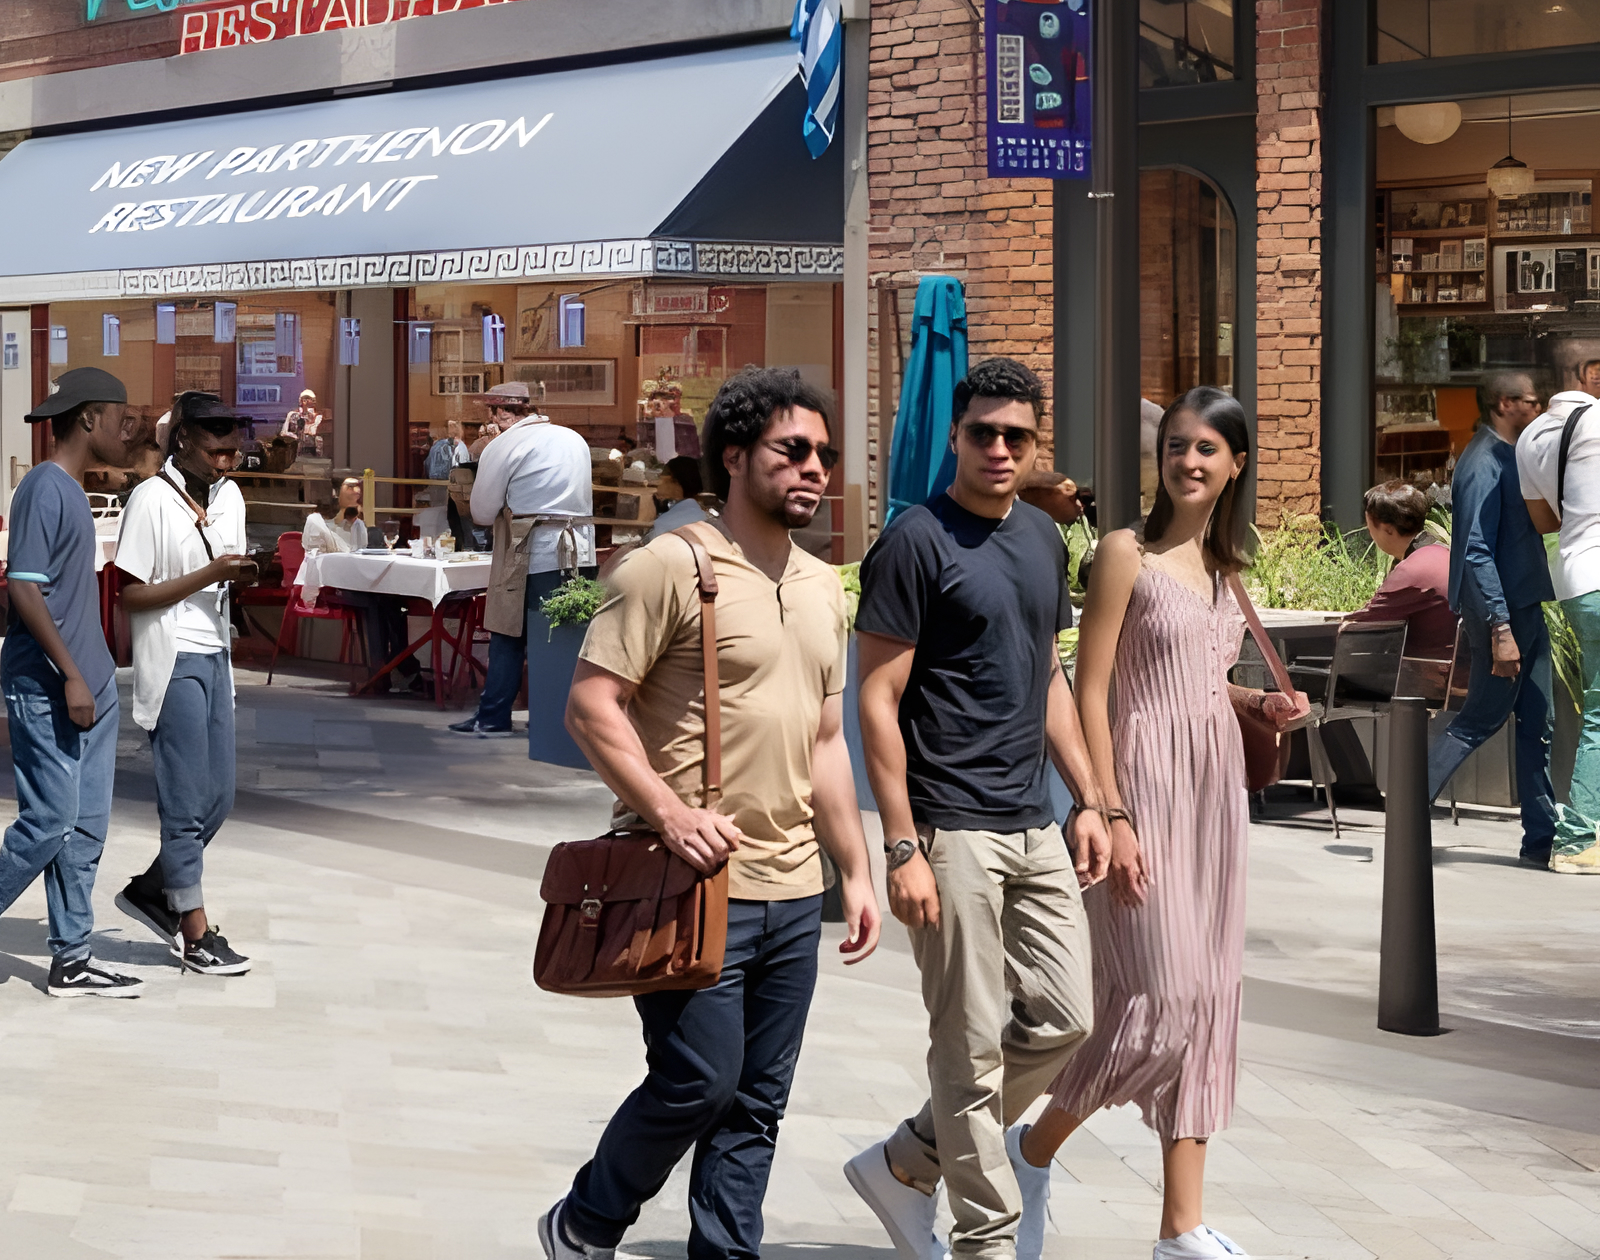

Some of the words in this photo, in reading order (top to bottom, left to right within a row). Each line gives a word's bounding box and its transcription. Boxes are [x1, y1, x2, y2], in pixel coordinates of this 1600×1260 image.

[90, 150, 215, 192] NEW
[205, 112, 555, 180] PARTHENON
[88, 175, 439, 234] RESTAURANT
